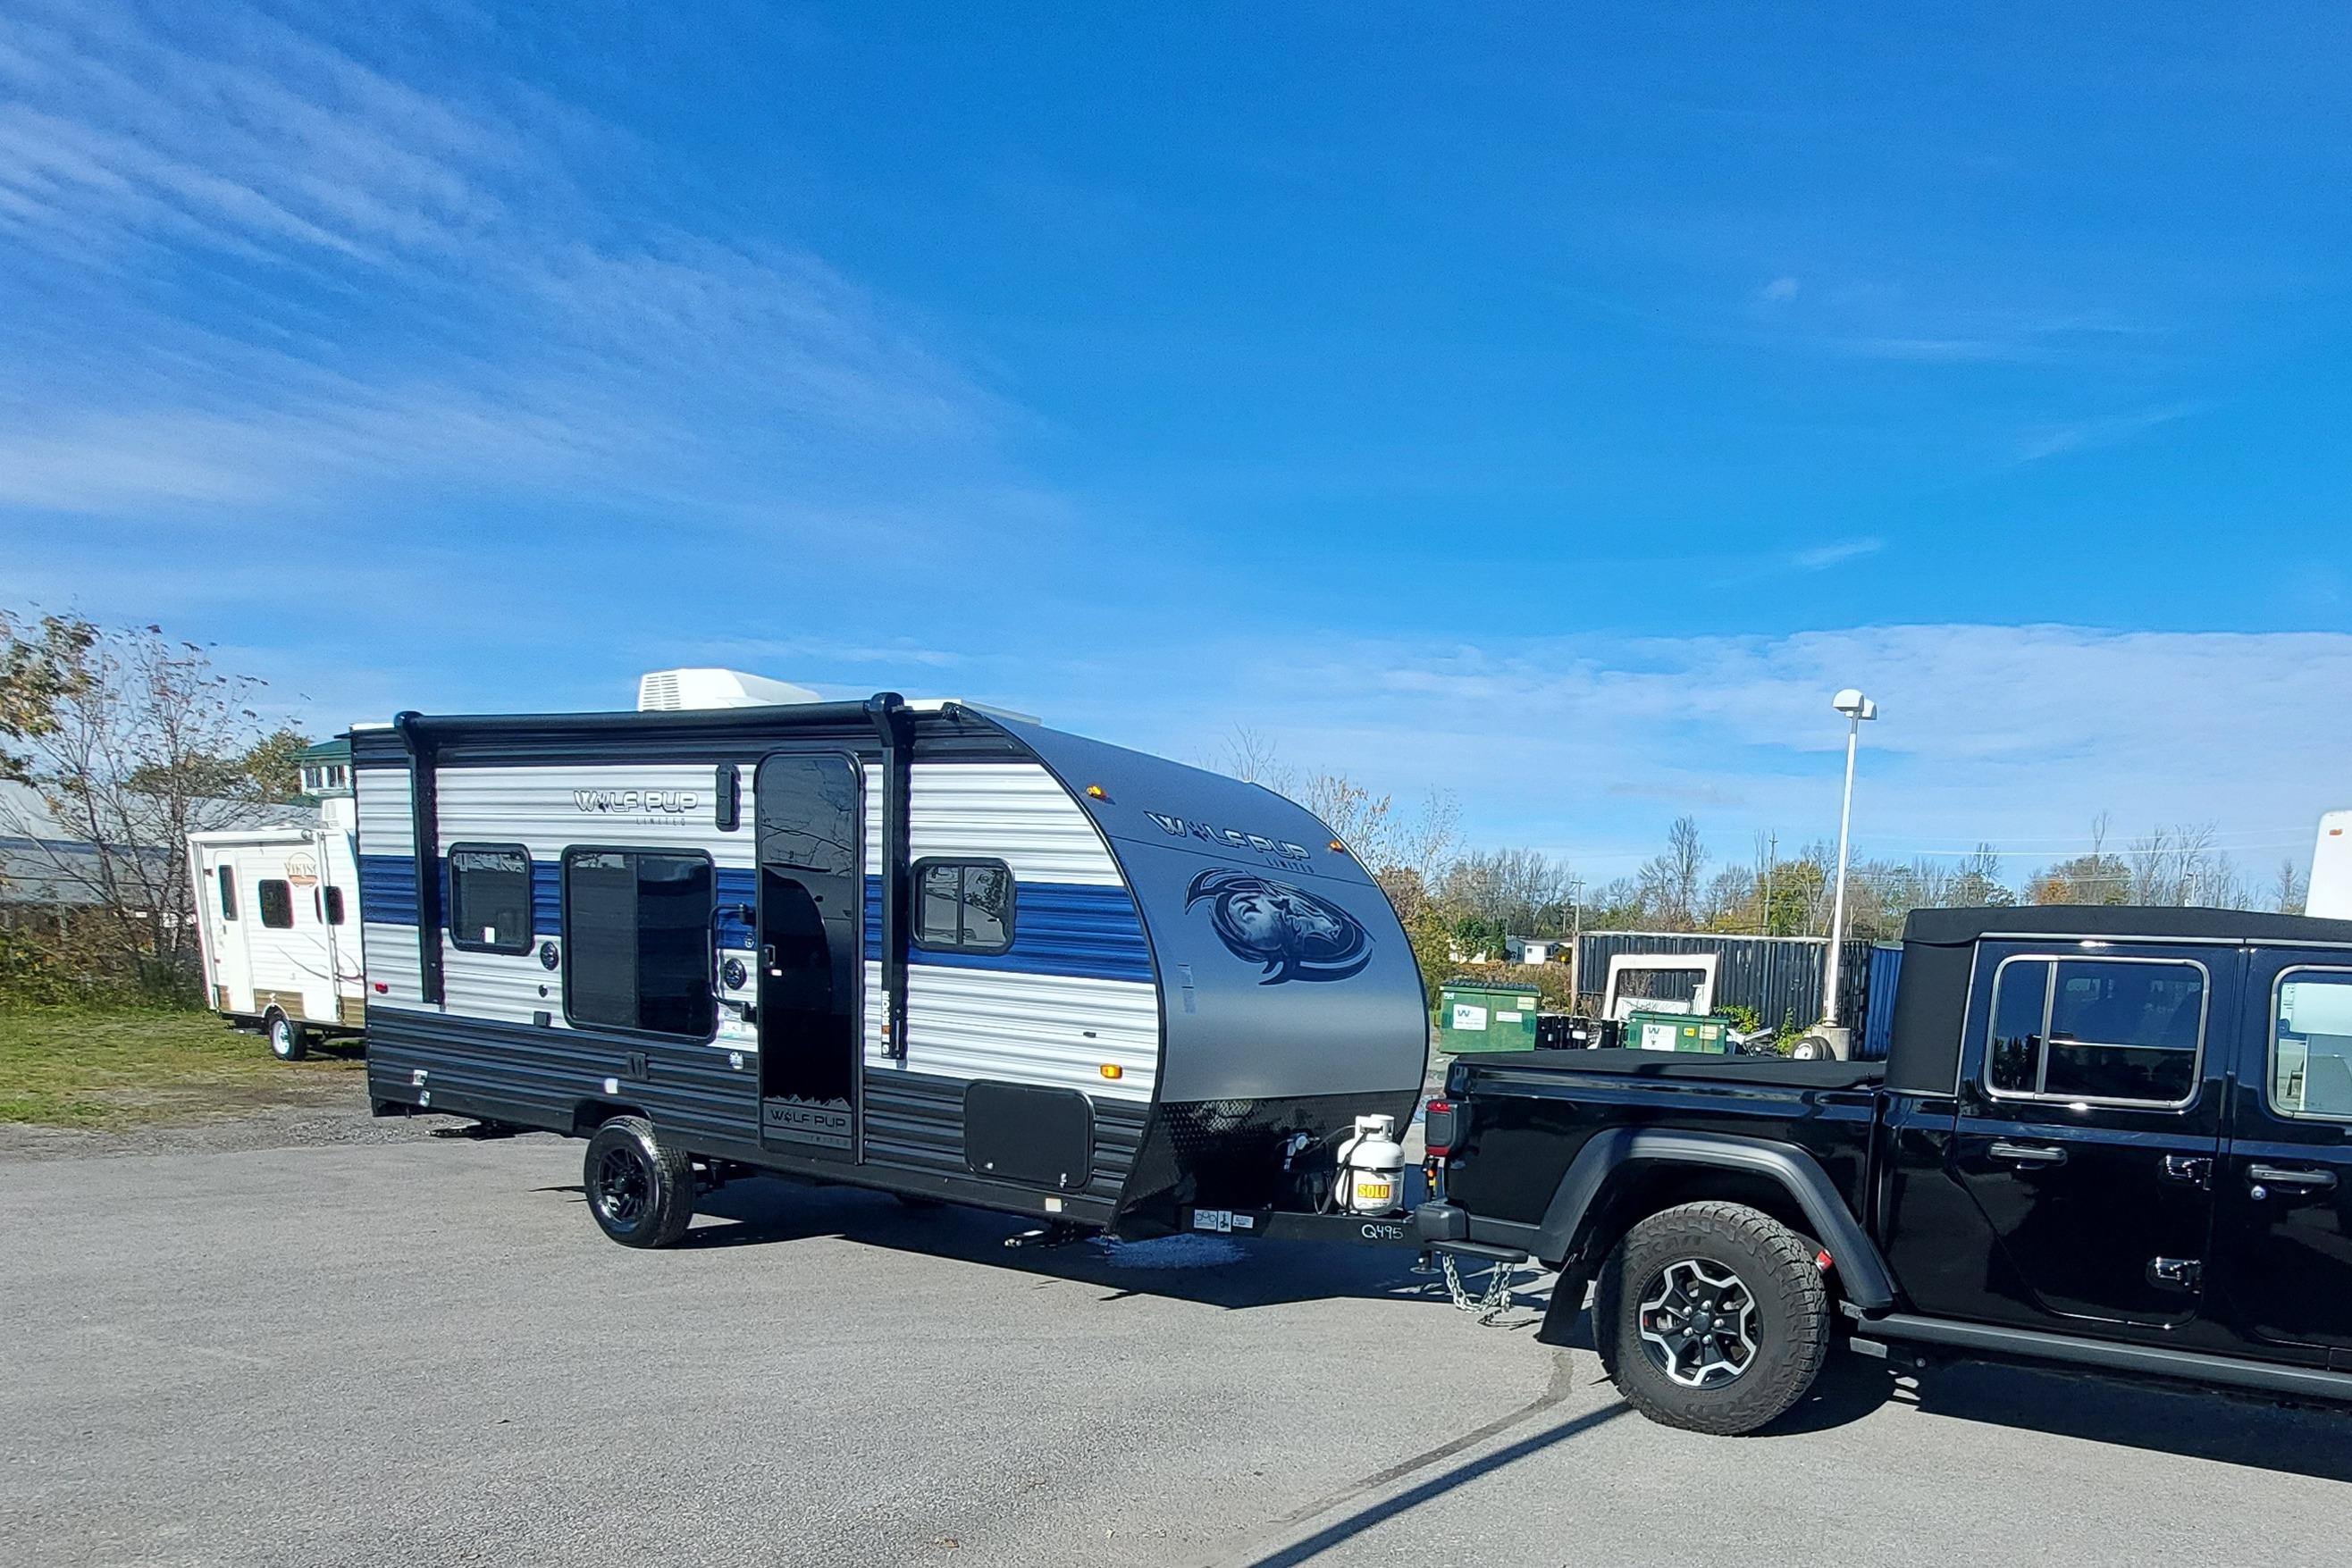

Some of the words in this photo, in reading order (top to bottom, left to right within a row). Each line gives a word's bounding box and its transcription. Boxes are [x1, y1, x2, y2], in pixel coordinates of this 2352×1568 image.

[644, 792, 698, 813] PUP
[635, 817, 686, 826] LIMITED
[1245, 833, 1311, 860] PUP
[814, 1115, 846, 1128] PUP
[1358, 1185, 1389, 1198] SOLD
[1361, 1223, 1404, 1240] Q495
